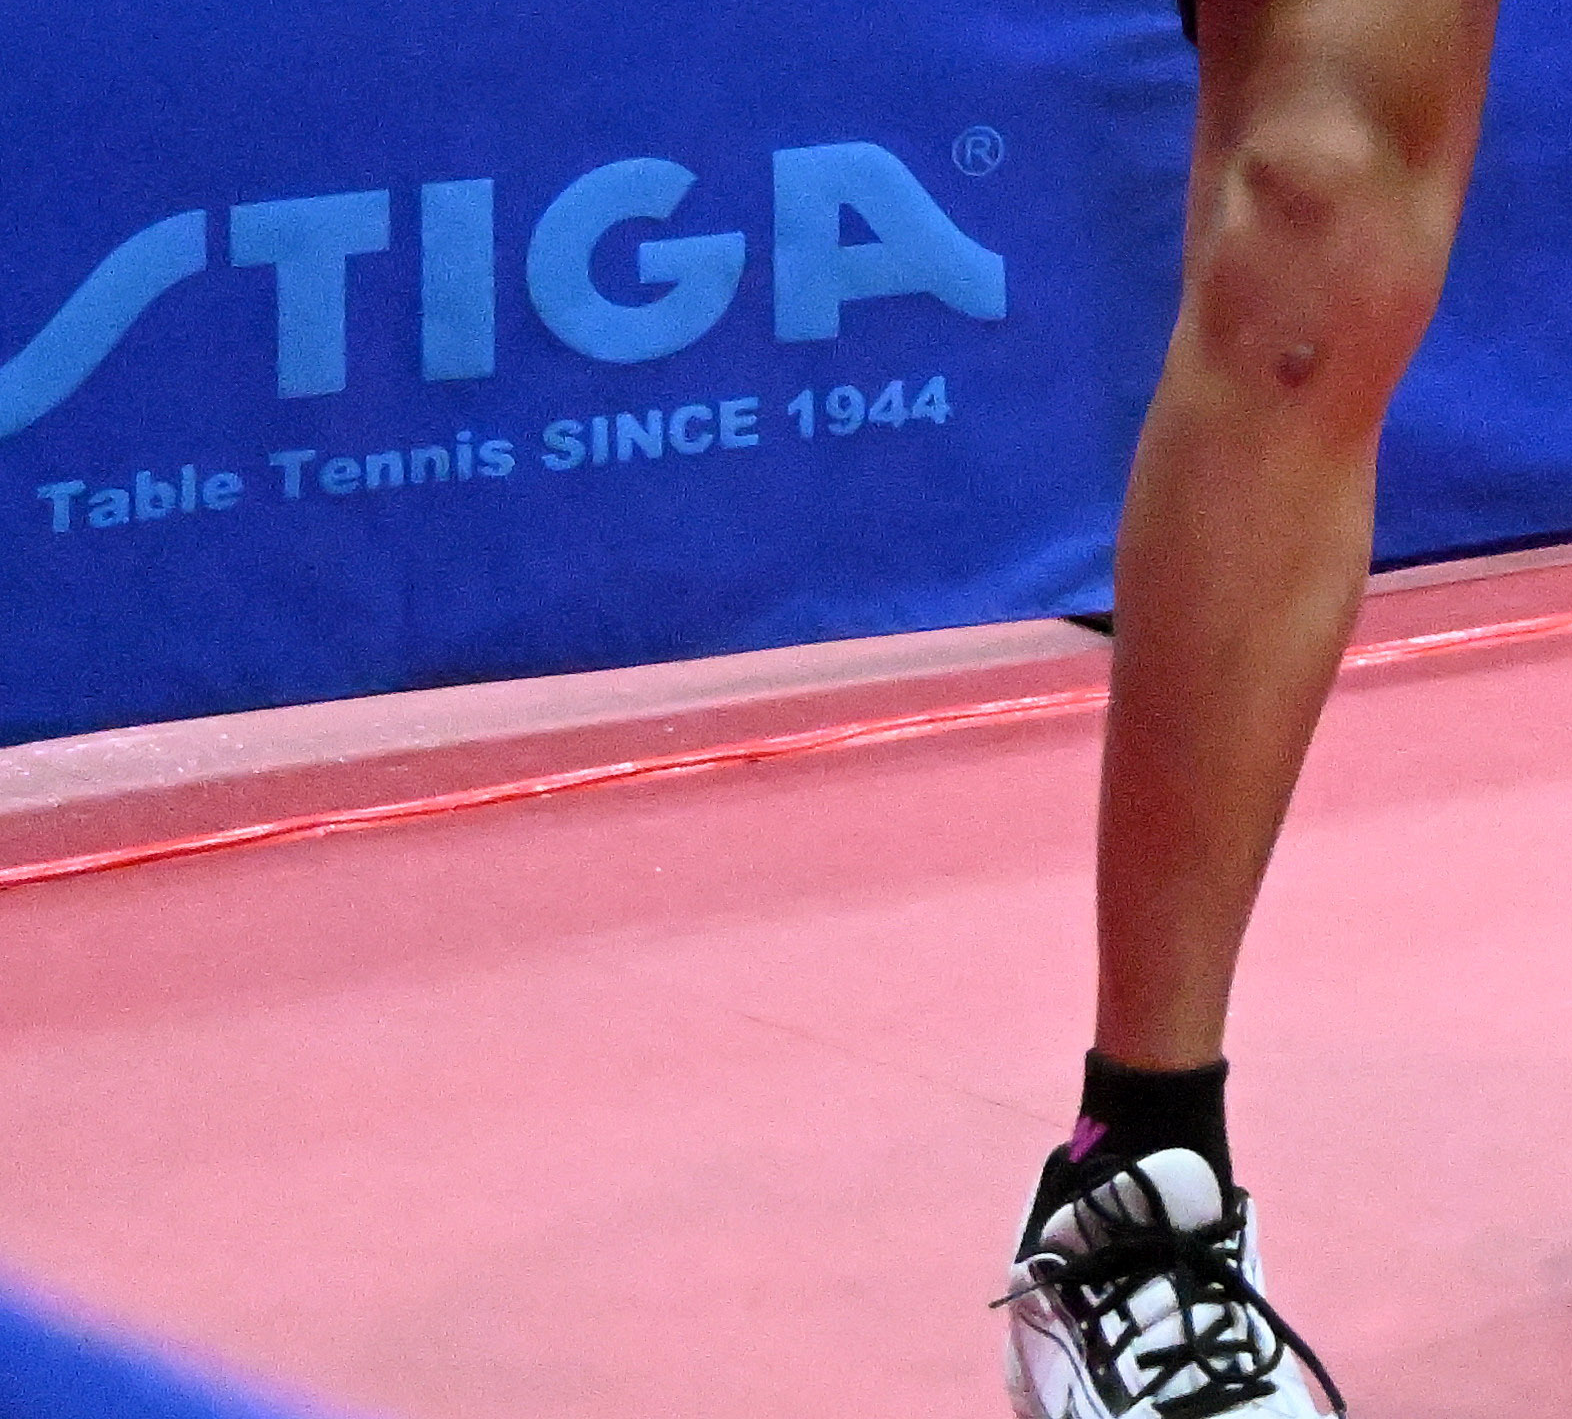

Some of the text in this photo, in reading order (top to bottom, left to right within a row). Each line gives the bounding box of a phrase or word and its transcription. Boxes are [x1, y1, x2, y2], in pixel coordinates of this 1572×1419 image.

[37, 373, 954, 534] Table Tennis SINCE 1944
